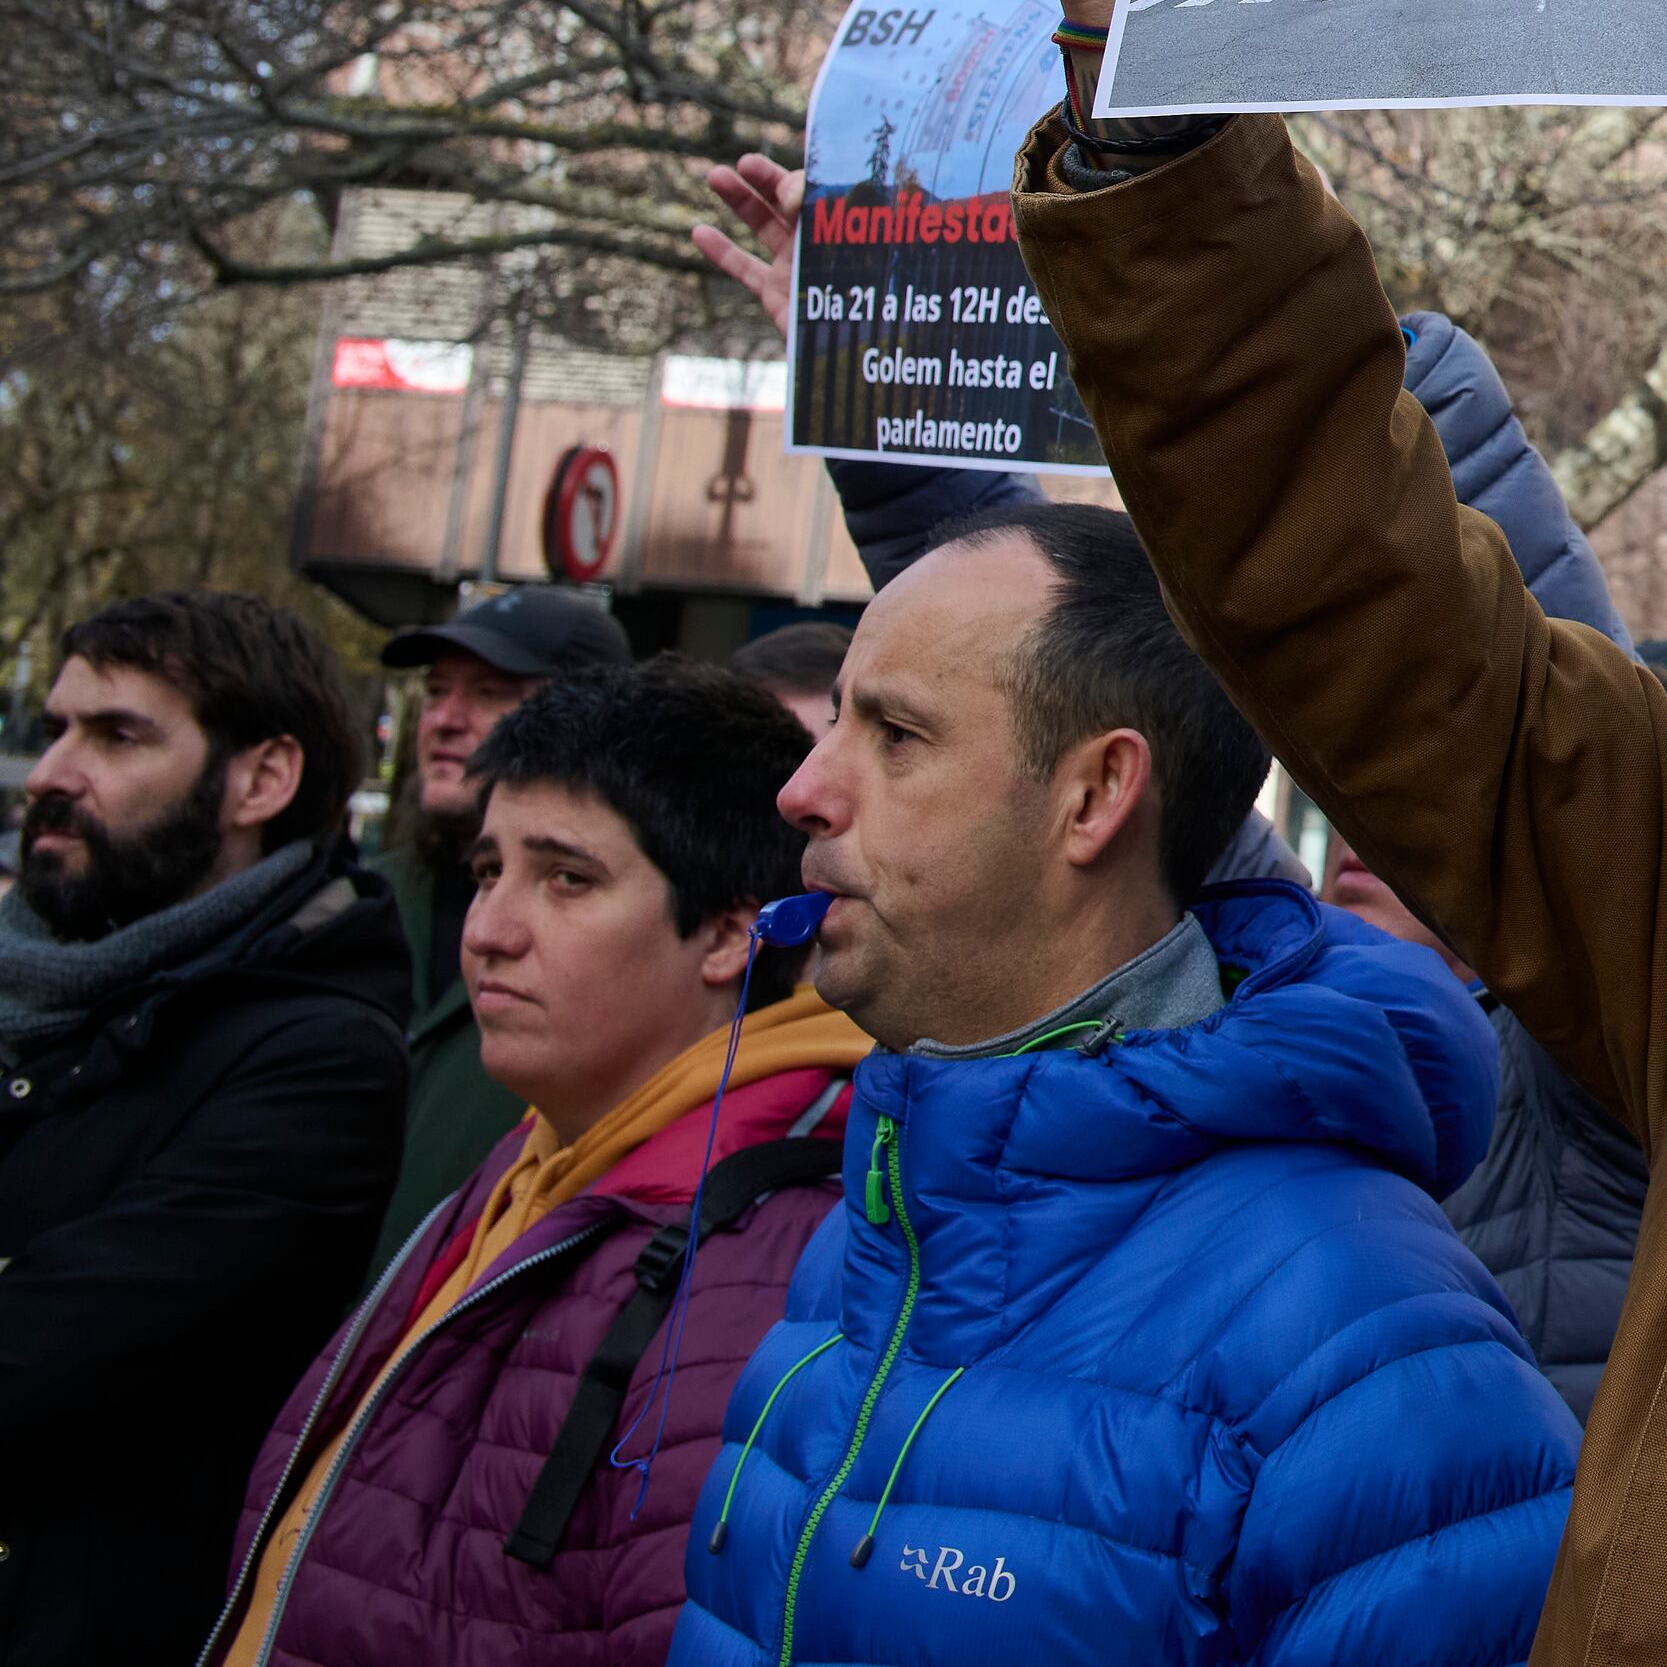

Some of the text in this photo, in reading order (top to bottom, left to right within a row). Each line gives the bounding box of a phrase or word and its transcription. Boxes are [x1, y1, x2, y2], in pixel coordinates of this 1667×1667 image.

[841, 8, 936, 49] BSH
[807, 285, 844, 321] Día
[848, 286, 876, 322] 21
[882, 294, 898, 322] a
[904, 284, 942, 323] las
[950, 286, 1000, 324] 12H
[862, 347, 1058, 391] Golem hasta el
[877, 409, 1022, 453] parlamento
[925, 1546, 1016, 1602] Rab
